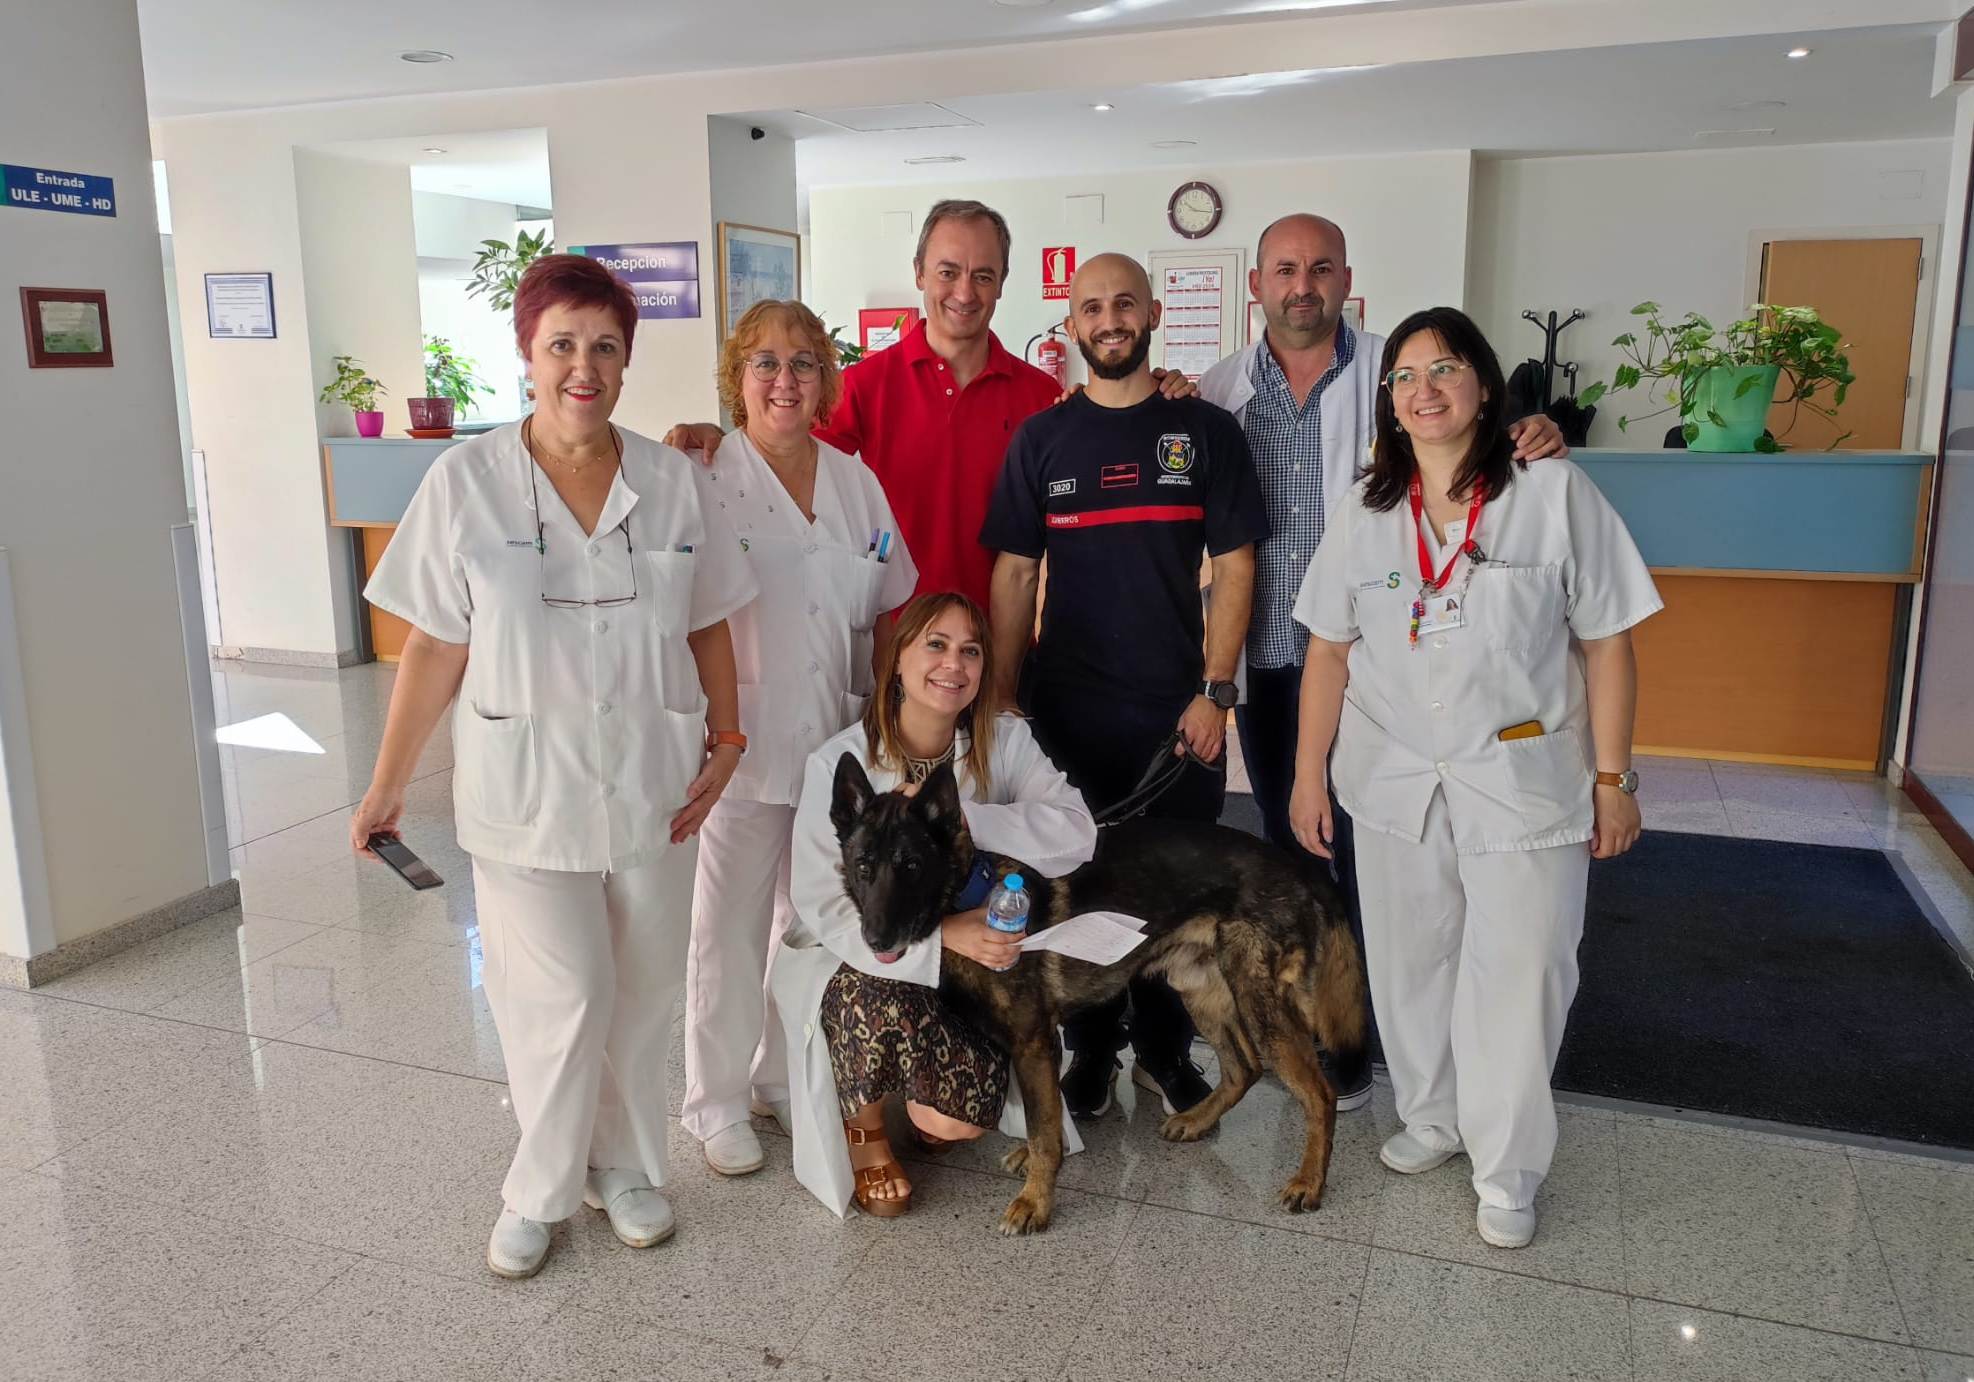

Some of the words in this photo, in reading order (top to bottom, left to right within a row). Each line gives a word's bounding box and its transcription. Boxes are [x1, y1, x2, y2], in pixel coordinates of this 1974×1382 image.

[36, 172, 85, 189] Entrada
[11, 188, 40, 202] ULE
[51, 192, 82, 207] UME
[92, 197, 112, 210] HD
[1043, 287, 1070, 297] EXTINTO
[1052, 482, 1071, 493] 3020
